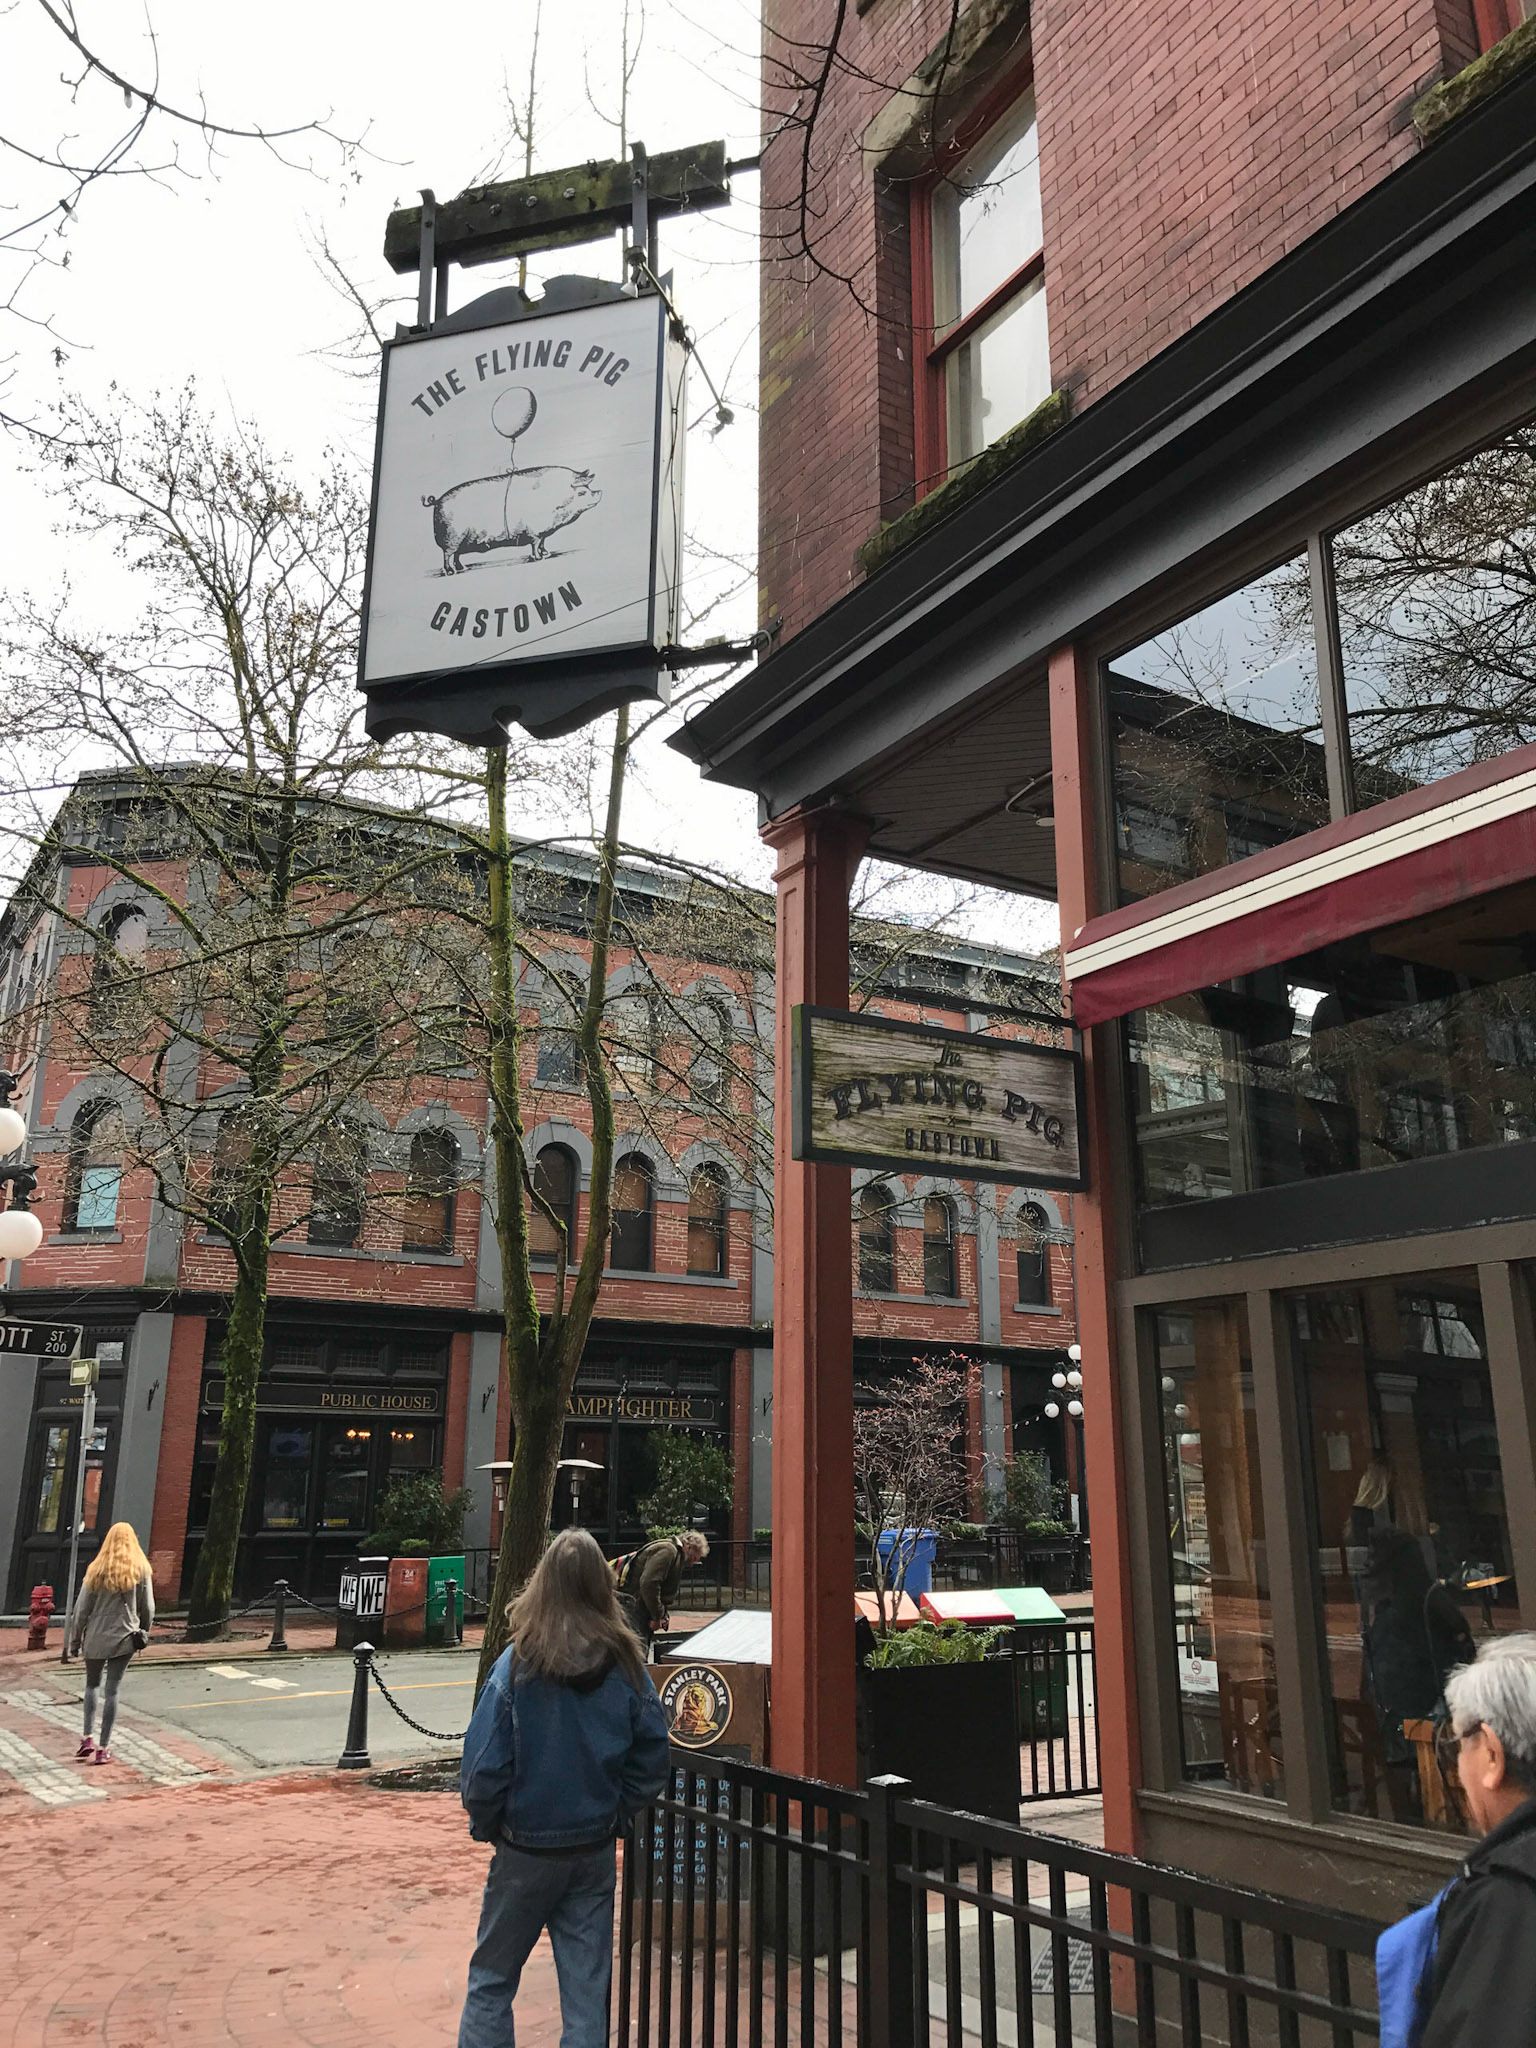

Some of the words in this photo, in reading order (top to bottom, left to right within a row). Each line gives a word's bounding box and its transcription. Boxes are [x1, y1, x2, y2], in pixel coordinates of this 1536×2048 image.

[411, 368, 466, 417] THE
[475, 340, 572, 381] FLYING
[579, 345, 630, 387] PIG
[430, 580, 583, 638] GASTOWN
[826, 1072, 986, 1120] FLYING
[1001, 1089, 1065, 1149] PIG
[45, 1342, 67, 1354] 200
[50, 1330, 65, 1342] ST
[320, 1393, 377, 1407] PUBLIC
[380, 1395, 432, 1409] HOUSE
[361, 1577, 385, 1613] WE
[665, 1670, 706, 1706] STANLEY
[705, 1673, 727, 1706] PARK
